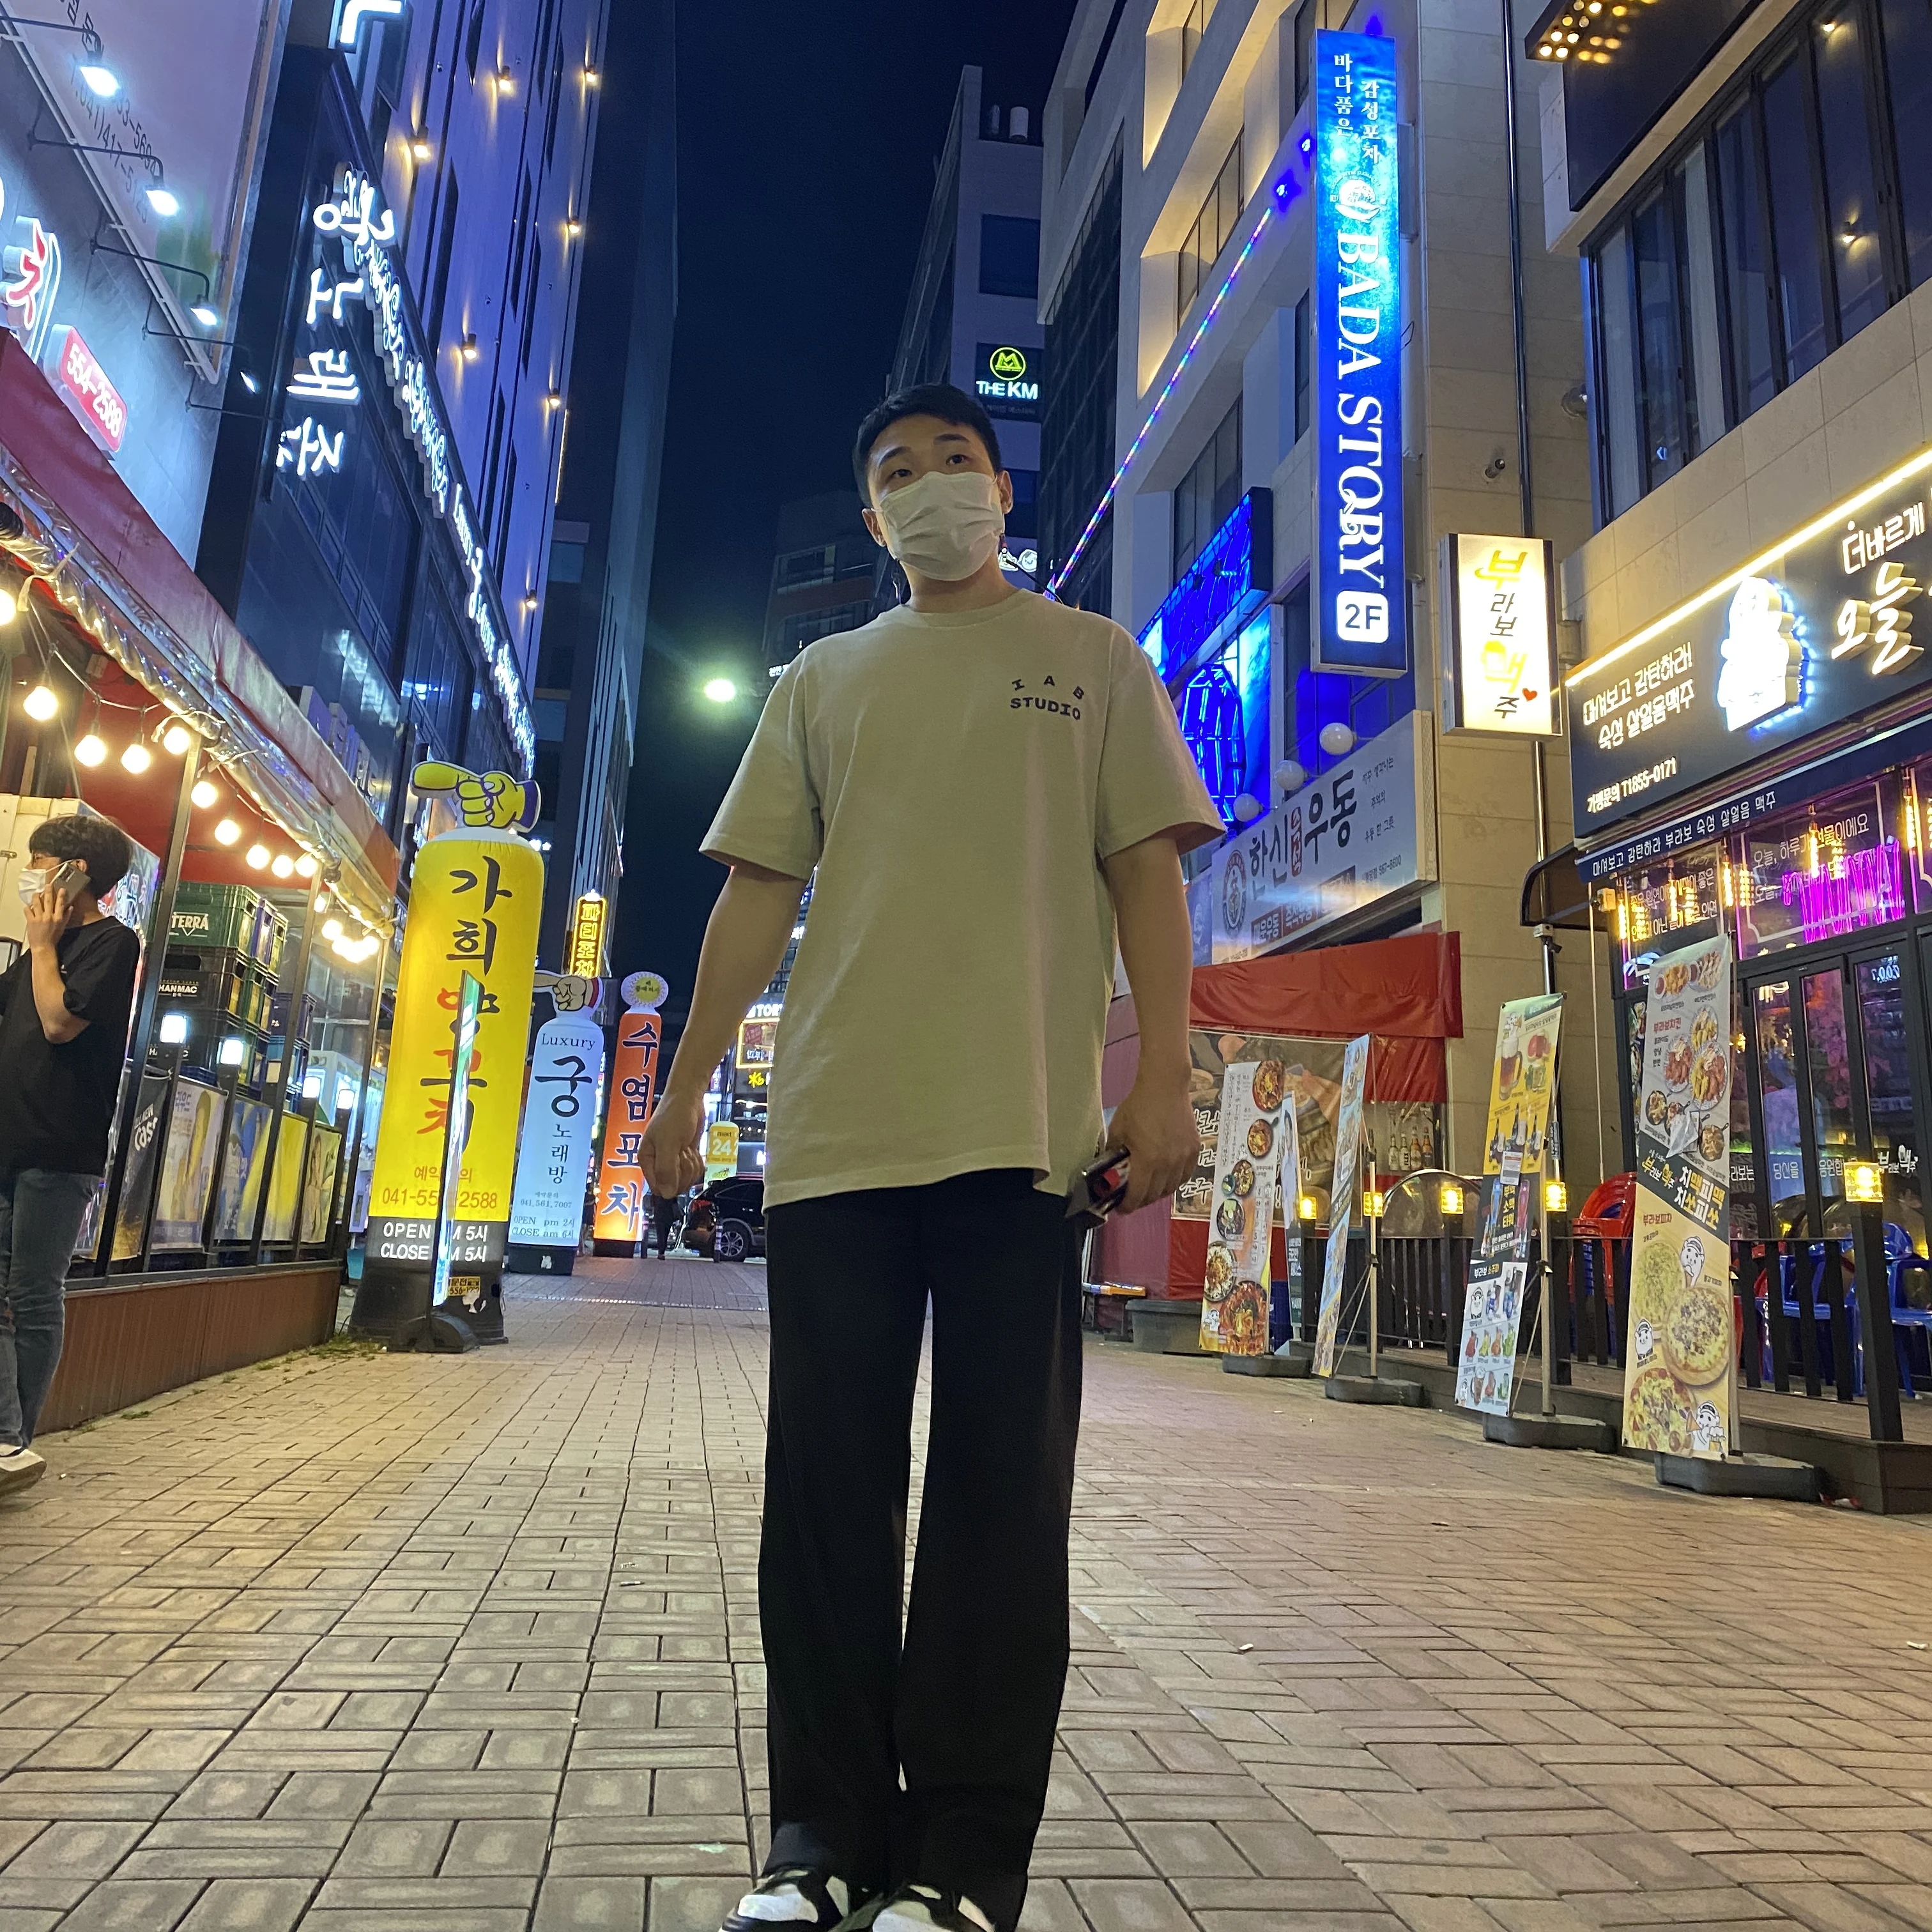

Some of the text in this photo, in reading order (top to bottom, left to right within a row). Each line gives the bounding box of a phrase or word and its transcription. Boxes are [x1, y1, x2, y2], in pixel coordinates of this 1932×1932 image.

[1360, 79, 1380, 164] 감성포차
[1337, 229, 1381, 380] BADA
[67, 342, 123, 438] 554-2588
[976, 380, 1038, 400] THE KM
[1338, 393, 1384, 588] STORY
[1345, 603, 1383, 630] 2F
[1010, 697, 1081, 720] STUDIO
[1598, 717, 1624, 750] 숙성
[1305, 769, 1358, 865] 우동
[1593, 790, 1776, 877] 마셔보고 감탄하라 부라보 숙성 살얼음 맥주
[171, 915, 209, 931] TERRA
[159, 985, 197, 993] HANMAC
[541, 1033, 595, 1050] Luxury
[535, 1055, 593, 1117] 궁
[548, 1123, 573, 1184] 노래방
[1773, 1162, 1800, 1180] 당신을
[382, 1188, 498, 1209] 041-55-2588
[383, 1221, 432, 1239] OPEN
[465, 1225, 488, 1243] 5시
[512, 1227, 574, 1239] CLOSE am 6시
[514, 1216, 575, 1228] OPEN pm 2시
[380, 1242, 430, 1261] CLOSE
[464, 1245, 487, 1263] 5시
